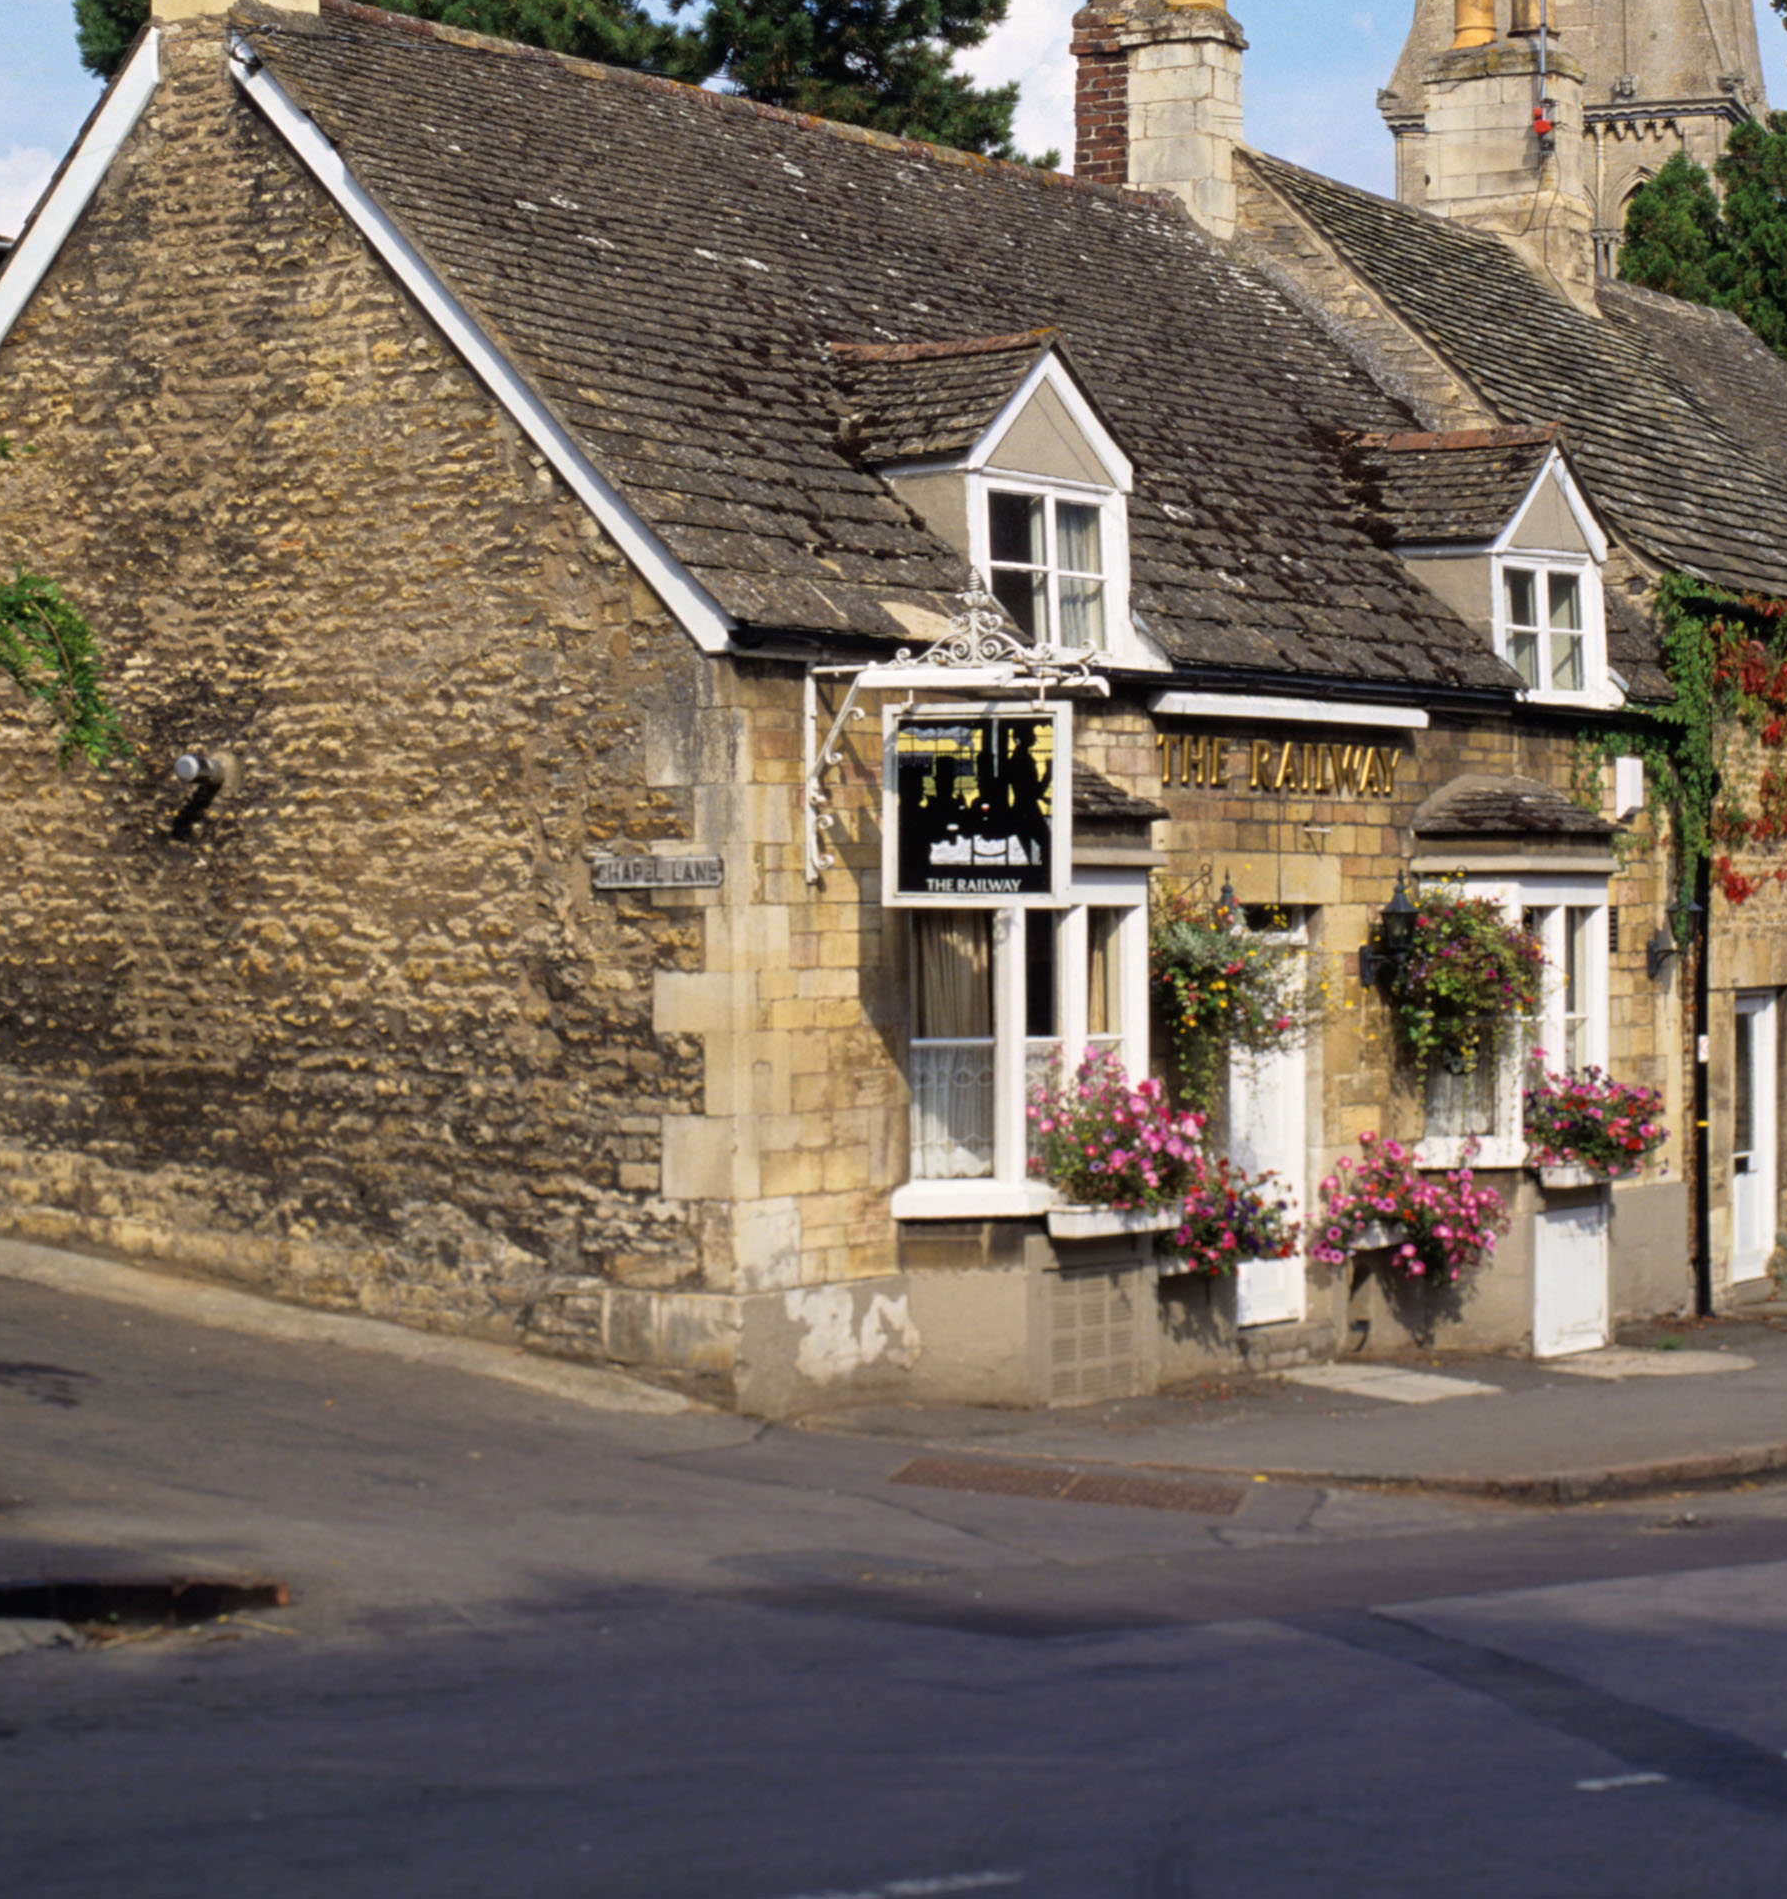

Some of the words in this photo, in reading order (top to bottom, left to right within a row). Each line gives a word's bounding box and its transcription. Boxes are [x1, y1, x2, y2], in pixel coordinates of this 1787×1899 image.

[1156, 733, 1232, 788] THE
[1249, 739, 1403, 796] RAILWAY
[598, 861, 665, 883] CHAPEL
[672, 860, 719, 882] LANE
[926, 878, 954, 892] THE
[956, 878, 1022, 892] RAILWAY
